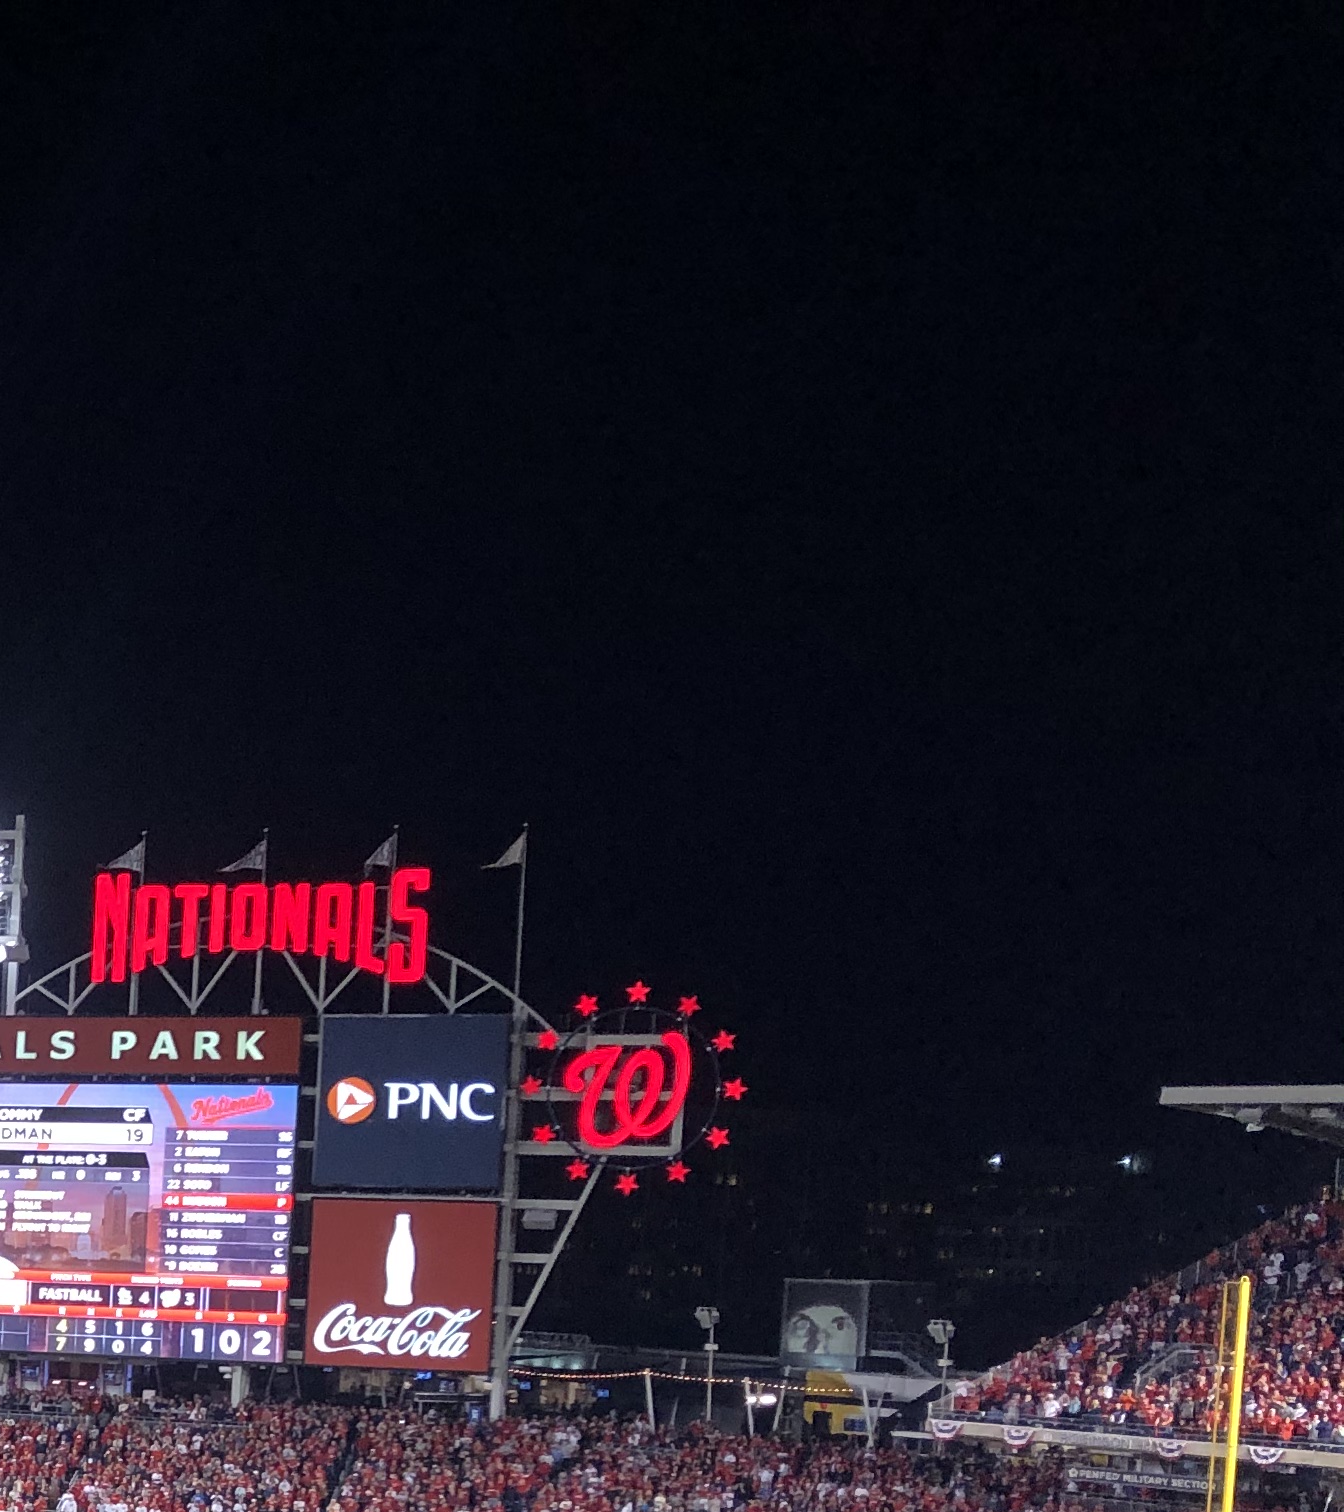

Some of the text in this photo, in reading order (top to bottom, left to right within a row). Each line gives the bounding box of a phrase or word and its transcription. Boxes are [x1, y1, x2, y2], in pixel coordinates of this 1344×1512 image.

[91, 868, 430, 983] NATIONALS
[110, 1030, 266, 1061] PARK
[123, 1108, 146, 1122] CF
[385, 1083, 494, 1121] PNC
[126, 1129, 144, 1142] 19
[39, 1288, 103, 1302] FASTBALL
[190, 1328, 204, 1352] 1
[219, 1331, 241, 1354] 0
[252, 1331, 271, 1355] 2
[314, 1303, 482, 1358] Coca-Cola
[1078, 1470, 1119, 1481] PENFED
[1123, 1474, 1169, 1486] MILITARY
